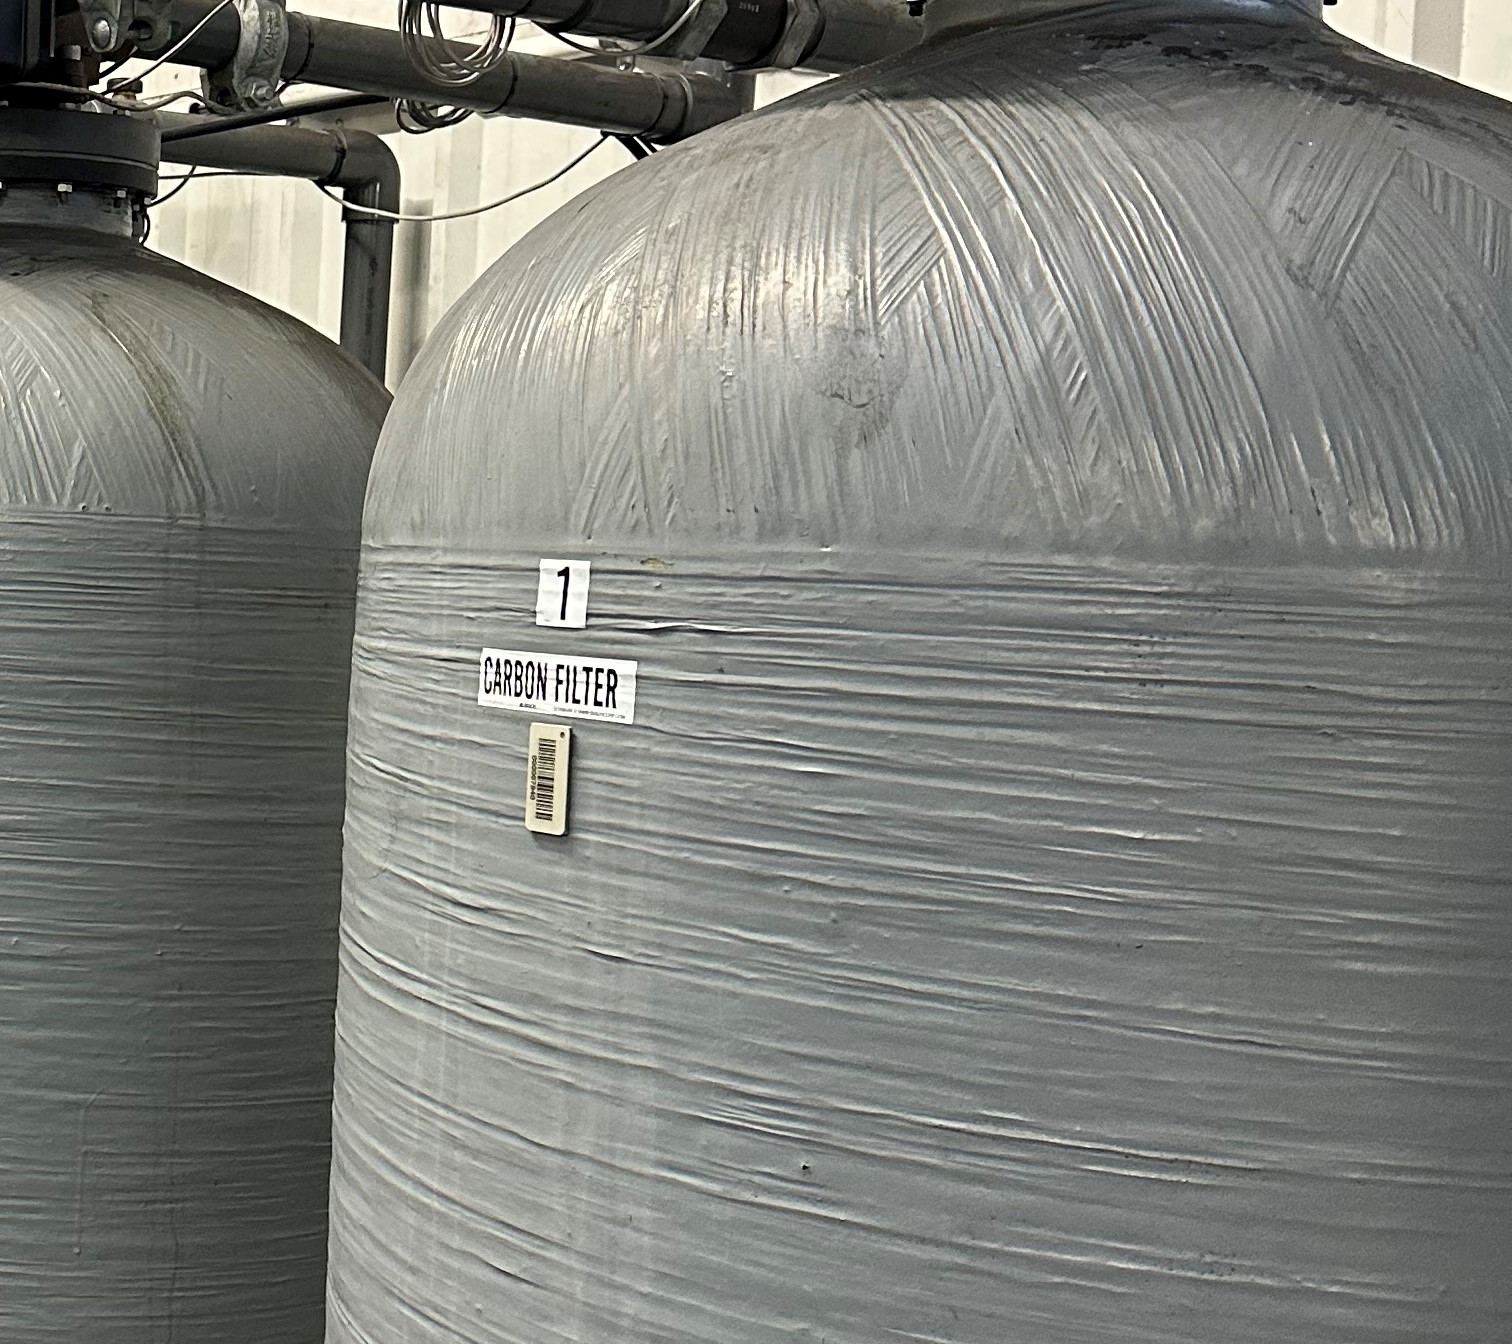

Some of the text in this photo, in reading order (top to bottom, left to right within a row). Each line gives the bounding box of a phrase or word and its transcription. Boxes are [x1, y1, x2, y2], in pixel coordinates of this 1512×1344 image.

[556, 565, 571, 621] 1
[483, 655, 619, 709] CARBON FILTER
